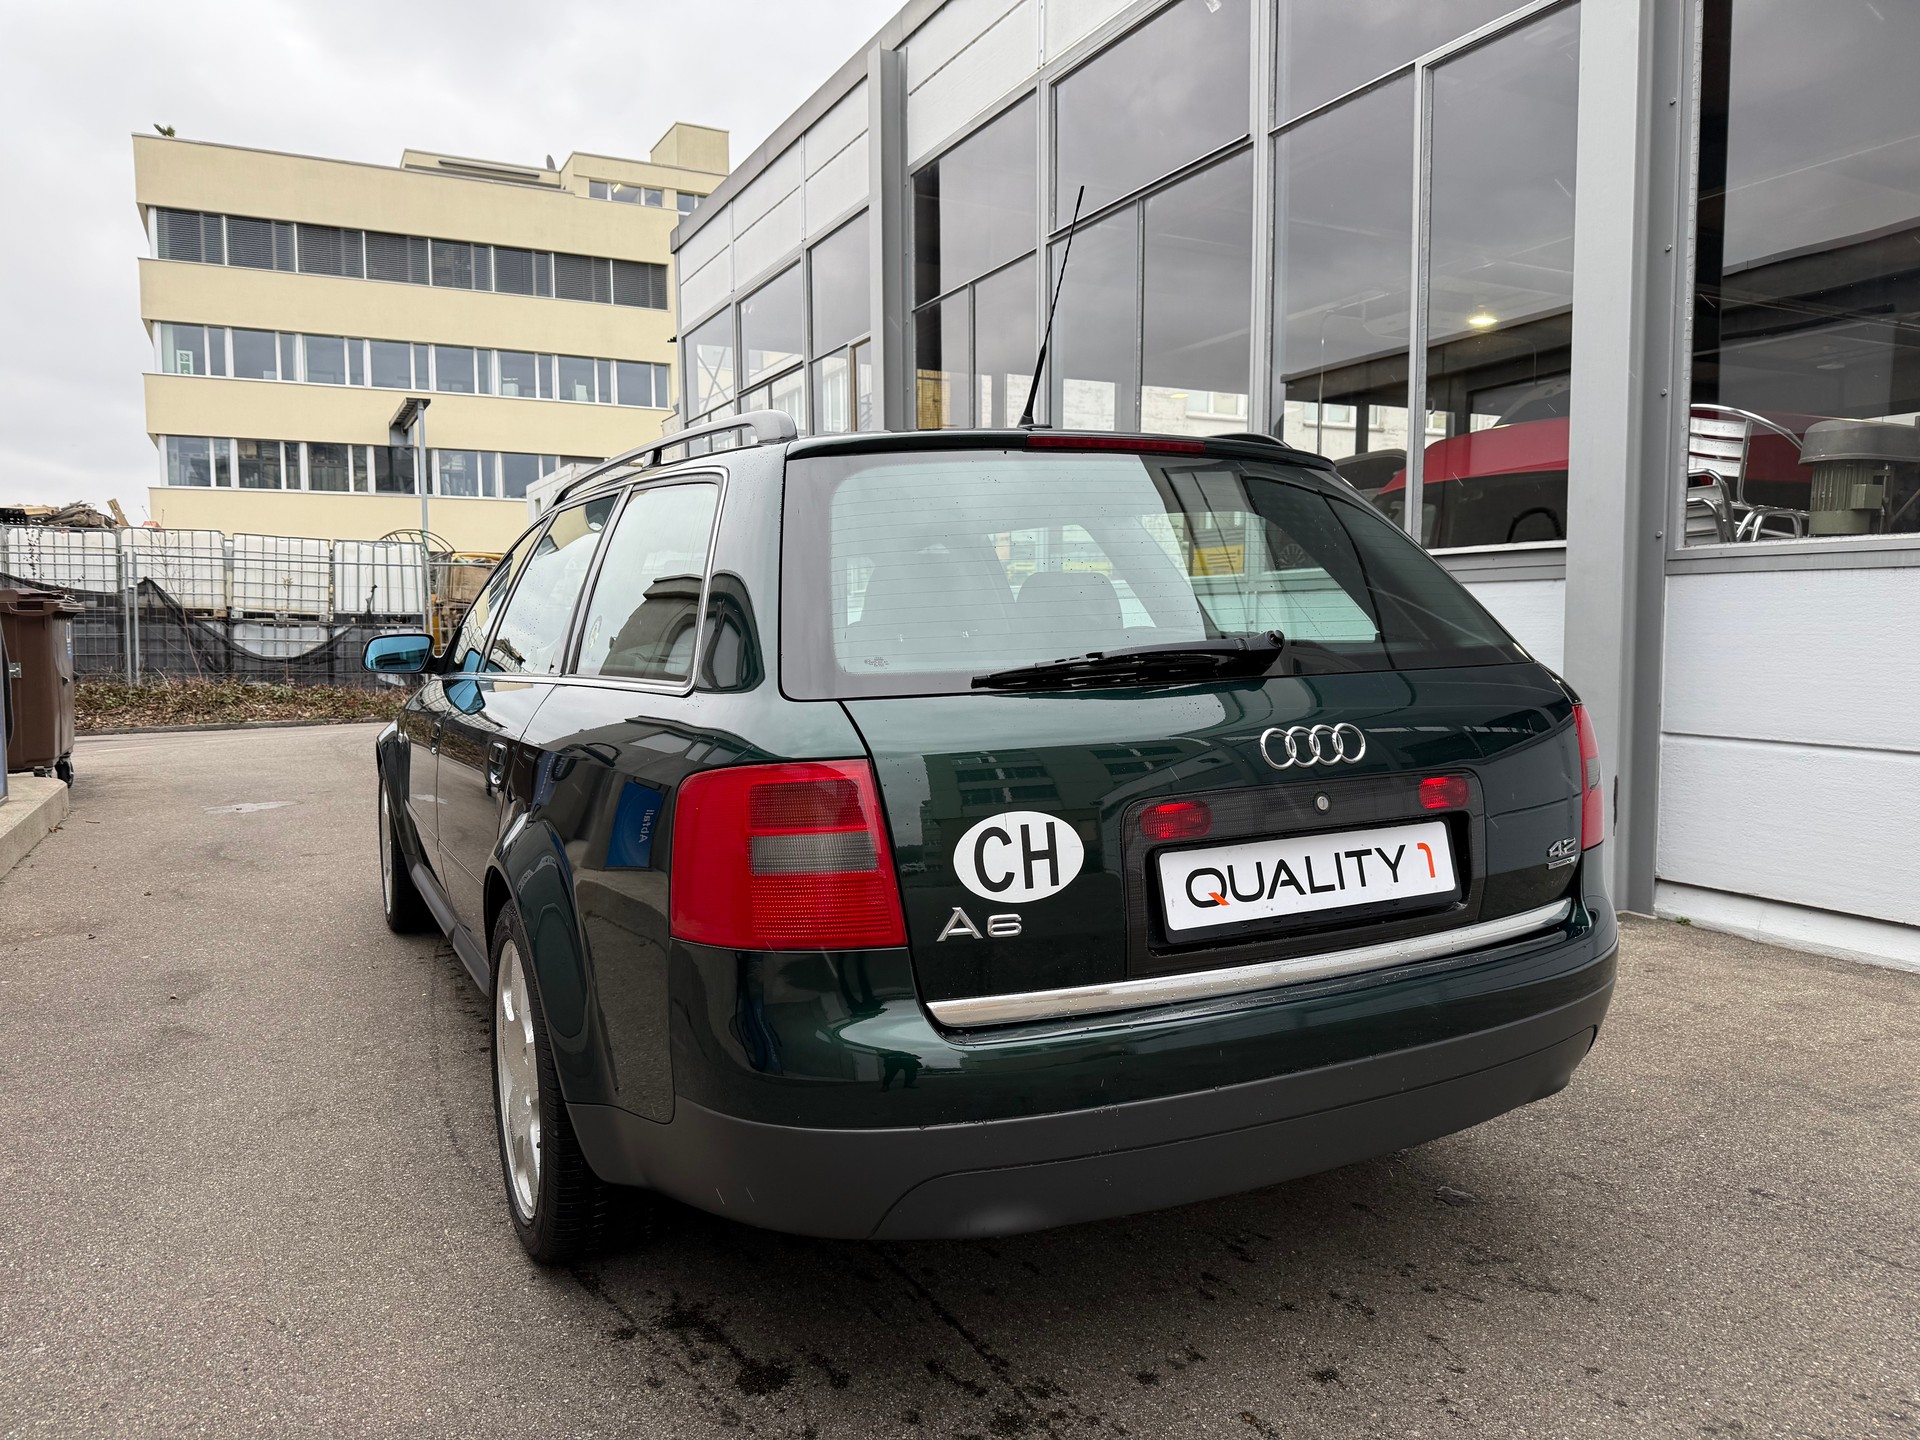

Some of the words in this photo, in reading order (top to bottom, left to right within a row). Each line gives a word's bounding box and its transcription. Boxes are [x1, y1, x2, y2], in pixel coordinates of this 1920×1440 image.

[974, 821, 1060, 893] CH
[1185, 844, 1406, 908] QUALITY
[1416, 842, 1436, 878] 1
[936, 906, 1022, 942] A6
